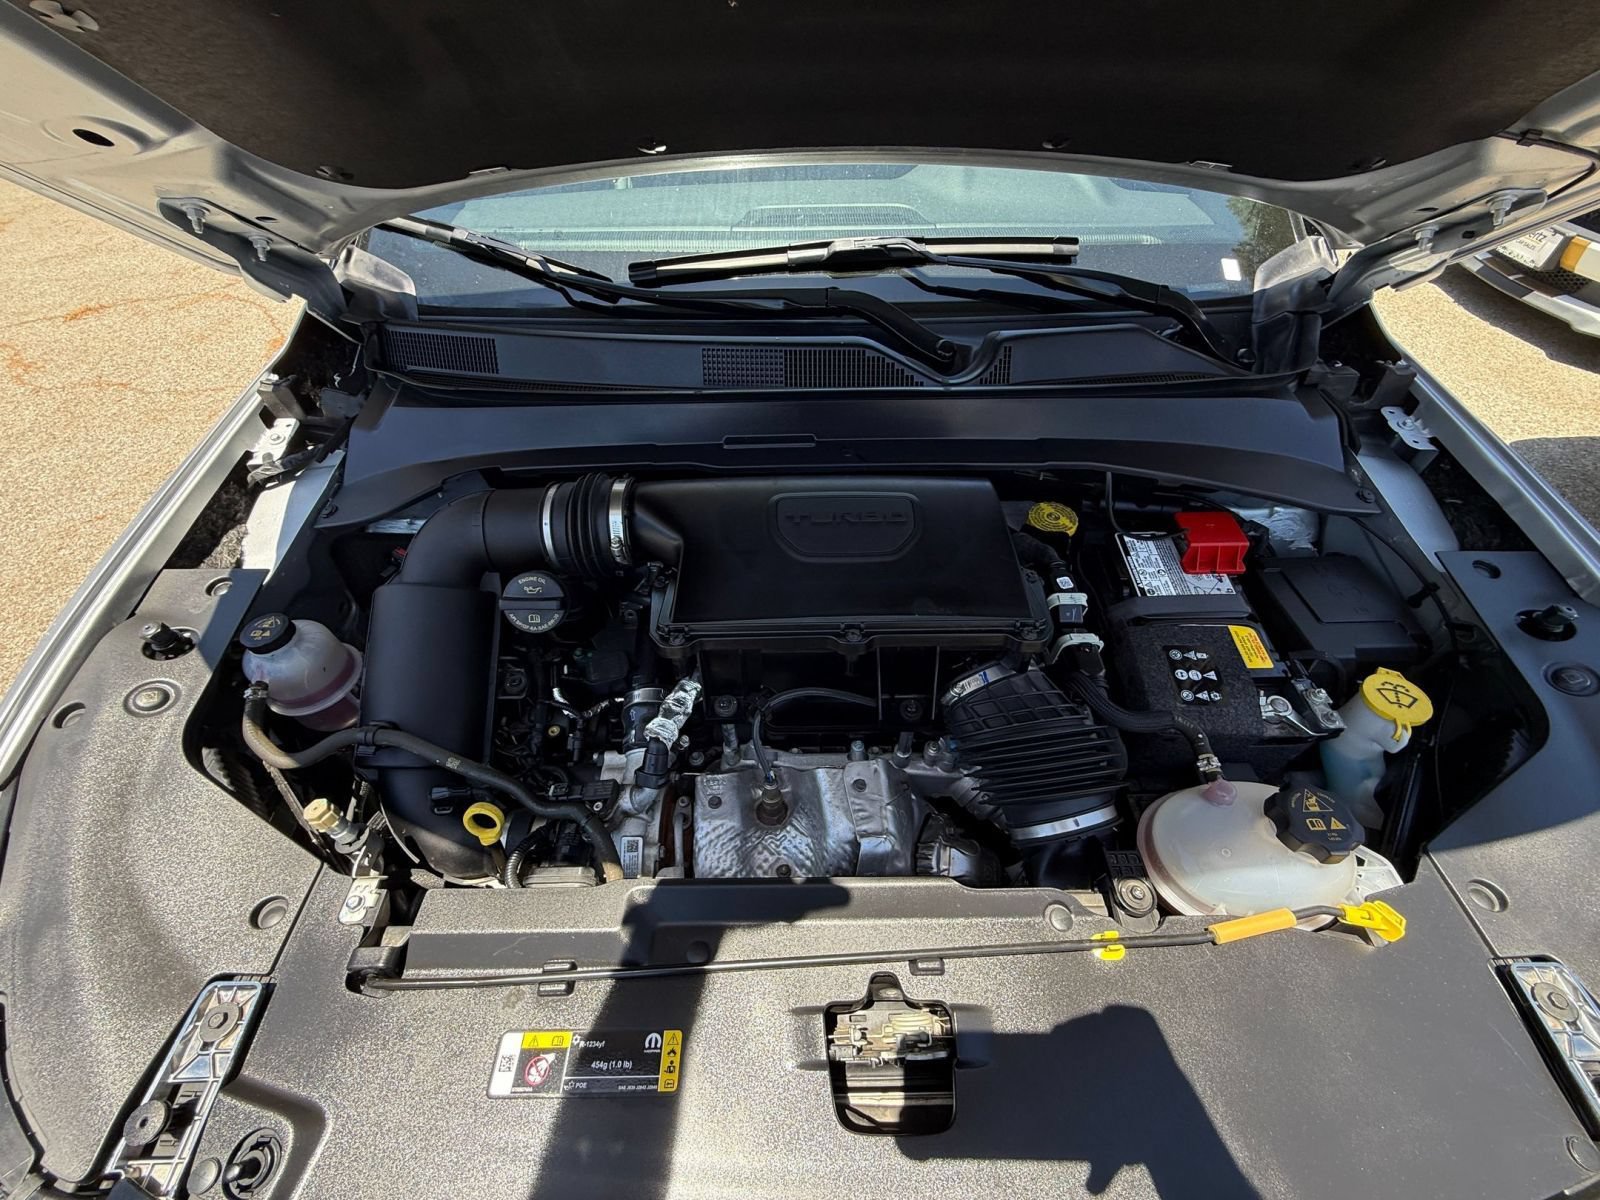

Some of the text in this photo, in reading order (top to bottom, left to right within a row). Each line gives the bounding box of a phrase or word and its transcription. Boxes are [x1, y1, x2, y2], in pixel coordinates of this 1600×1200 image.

[1528, 231, 1547, 242] ertz
[518, 576, 546, 585] ENGINE OIL
[579, 1039, 606, 1050] R-1234yf
[591, 1060, 633, 1071] 454g (1.0 lb)
[575, 1082, 588, 1090] POE
